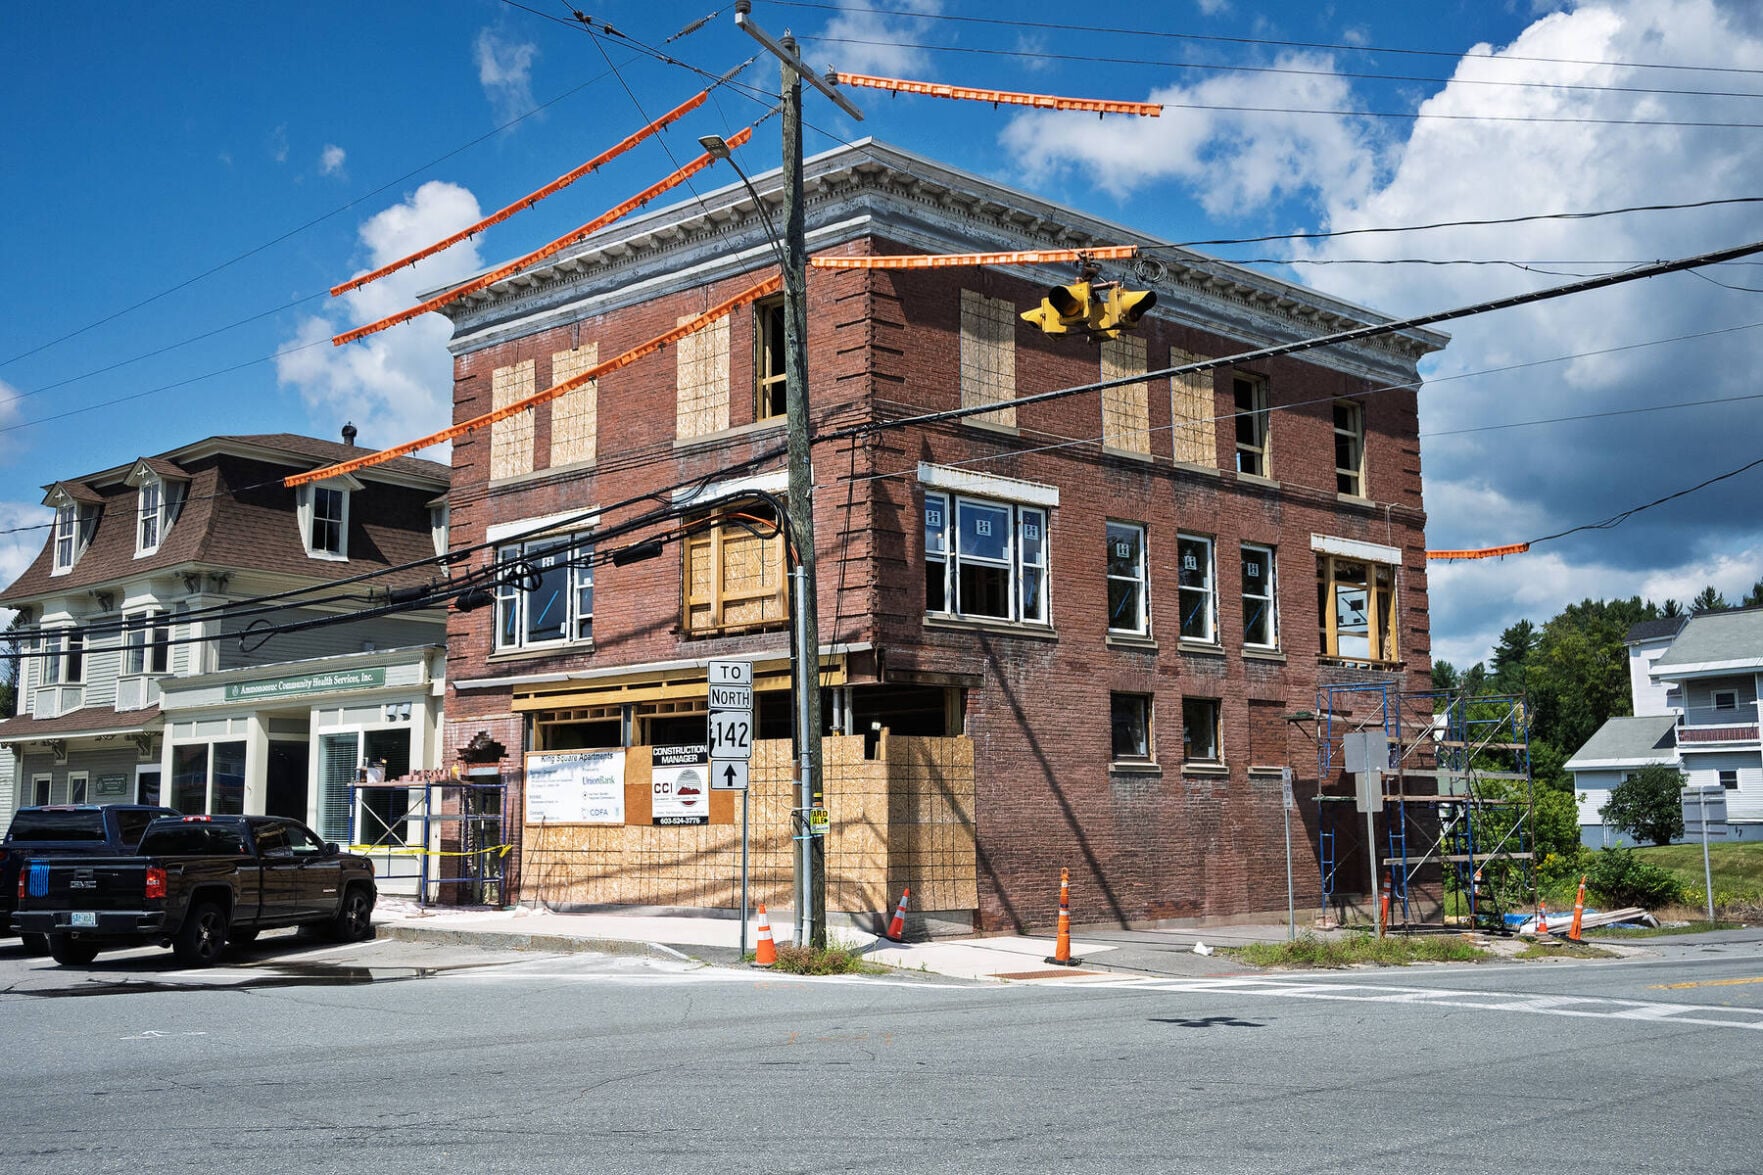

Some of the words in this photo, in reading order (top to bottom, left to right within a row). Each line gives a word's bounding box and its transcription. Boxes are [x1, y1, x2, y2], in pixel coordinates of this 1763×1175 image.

[720, 665, 741, 679] TO
[278, 679, 312, 691] Community
[312, 676, 333, 687] Health
[361, 673, 374, 682] Inc.
[711, 688, 749, 705] NORTH
[716, 722, 748, 747] 142
[653, 745, 708, 756] CONSTRUCTION
[557, 754, 578, 763] Square
[579, 752, 614, 762] Apartments
[661, 754, 698, 764] MANAGER
[654, 783, 673, 794] CCI
[590, 808, 609, 817] CDFA
